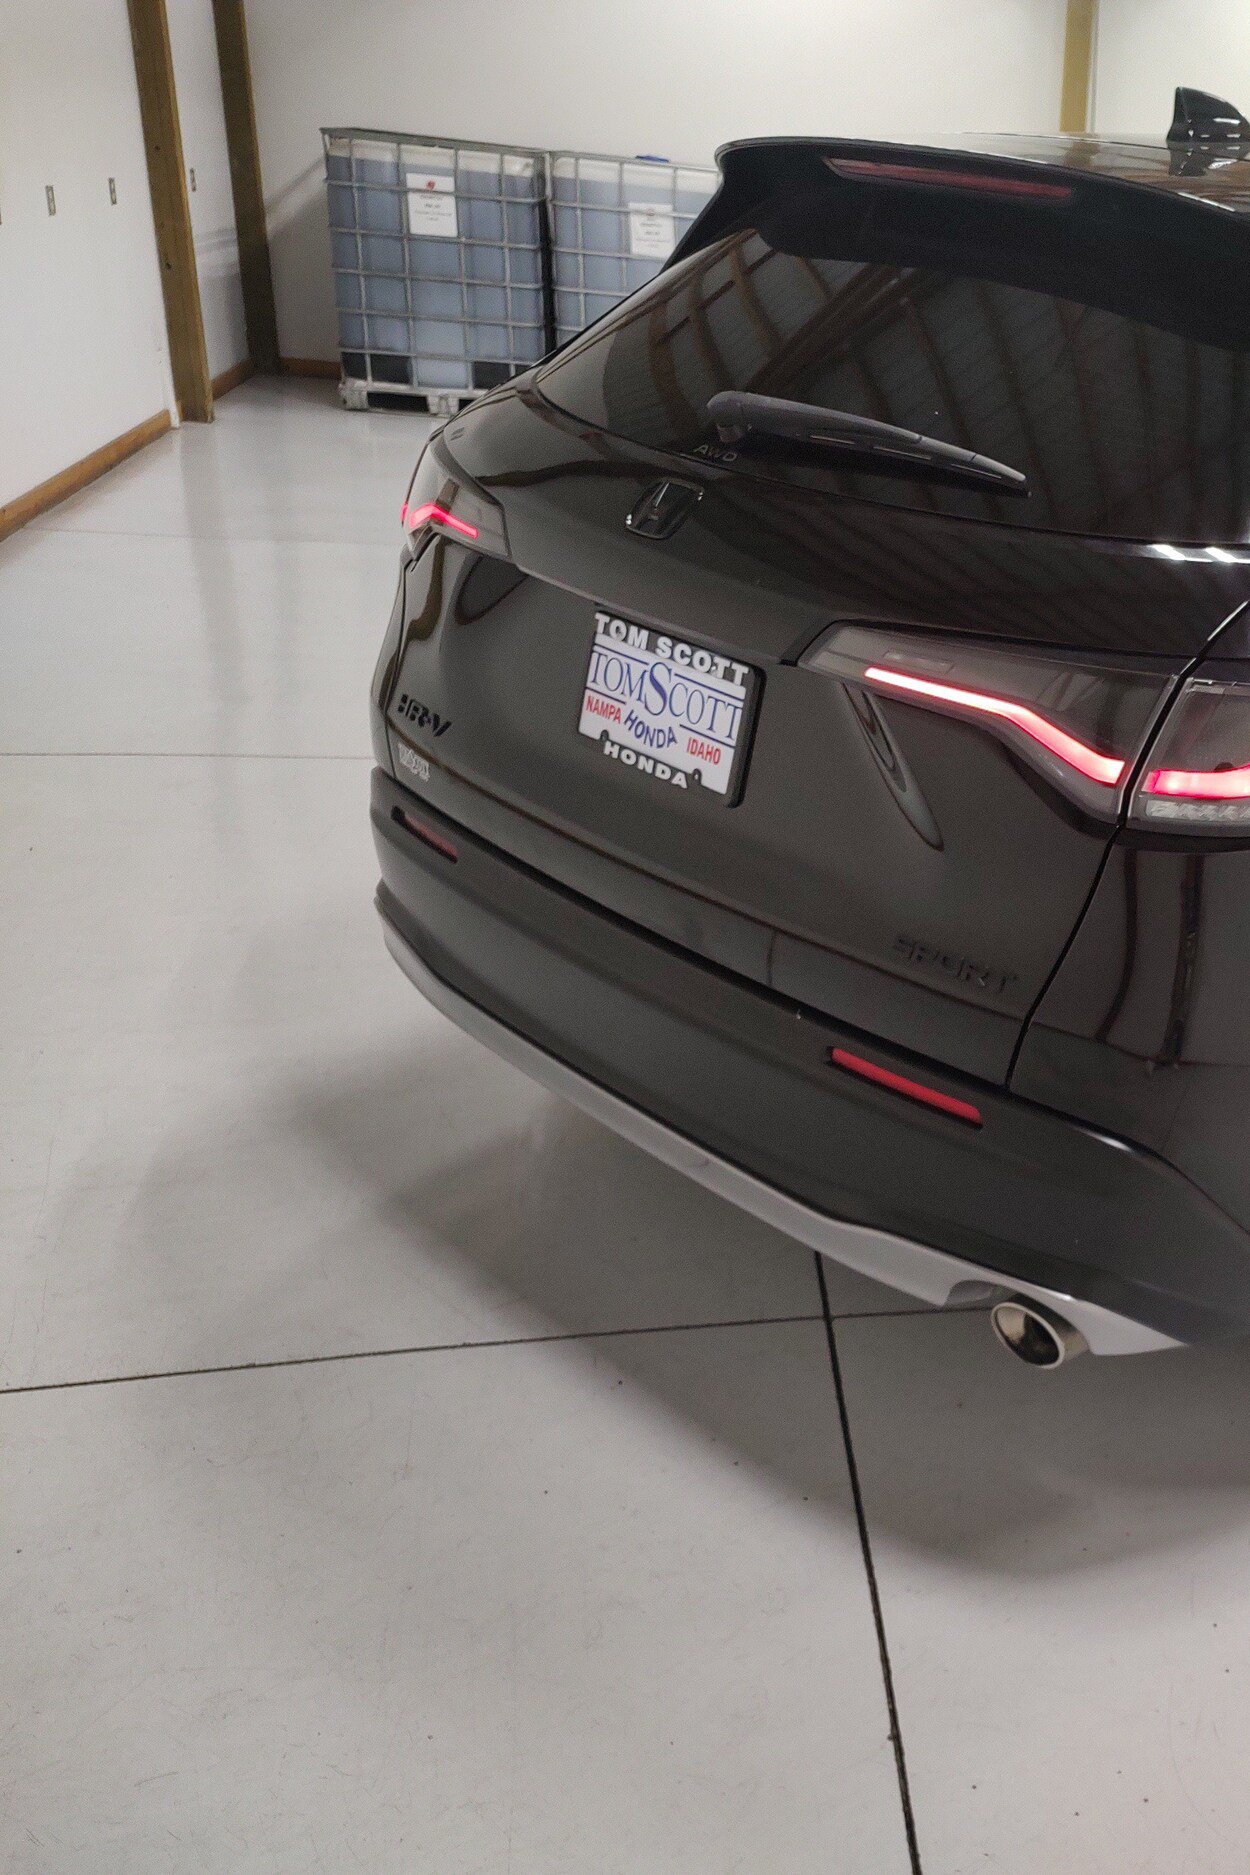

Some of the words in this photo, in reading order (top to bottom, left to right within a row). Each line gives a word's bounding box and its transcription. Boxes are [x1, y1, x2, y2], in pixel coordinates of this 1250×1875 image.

[594, 612, 650, 651] TOM
[656, 638, 749, 687] SCOTT
[585, 695, 622, 726] NAMPA
[624, 709, 678, 749] HONDA
[603, 740, 688, 789] HONDA
[686, 737, 721, 766] IDAHO
